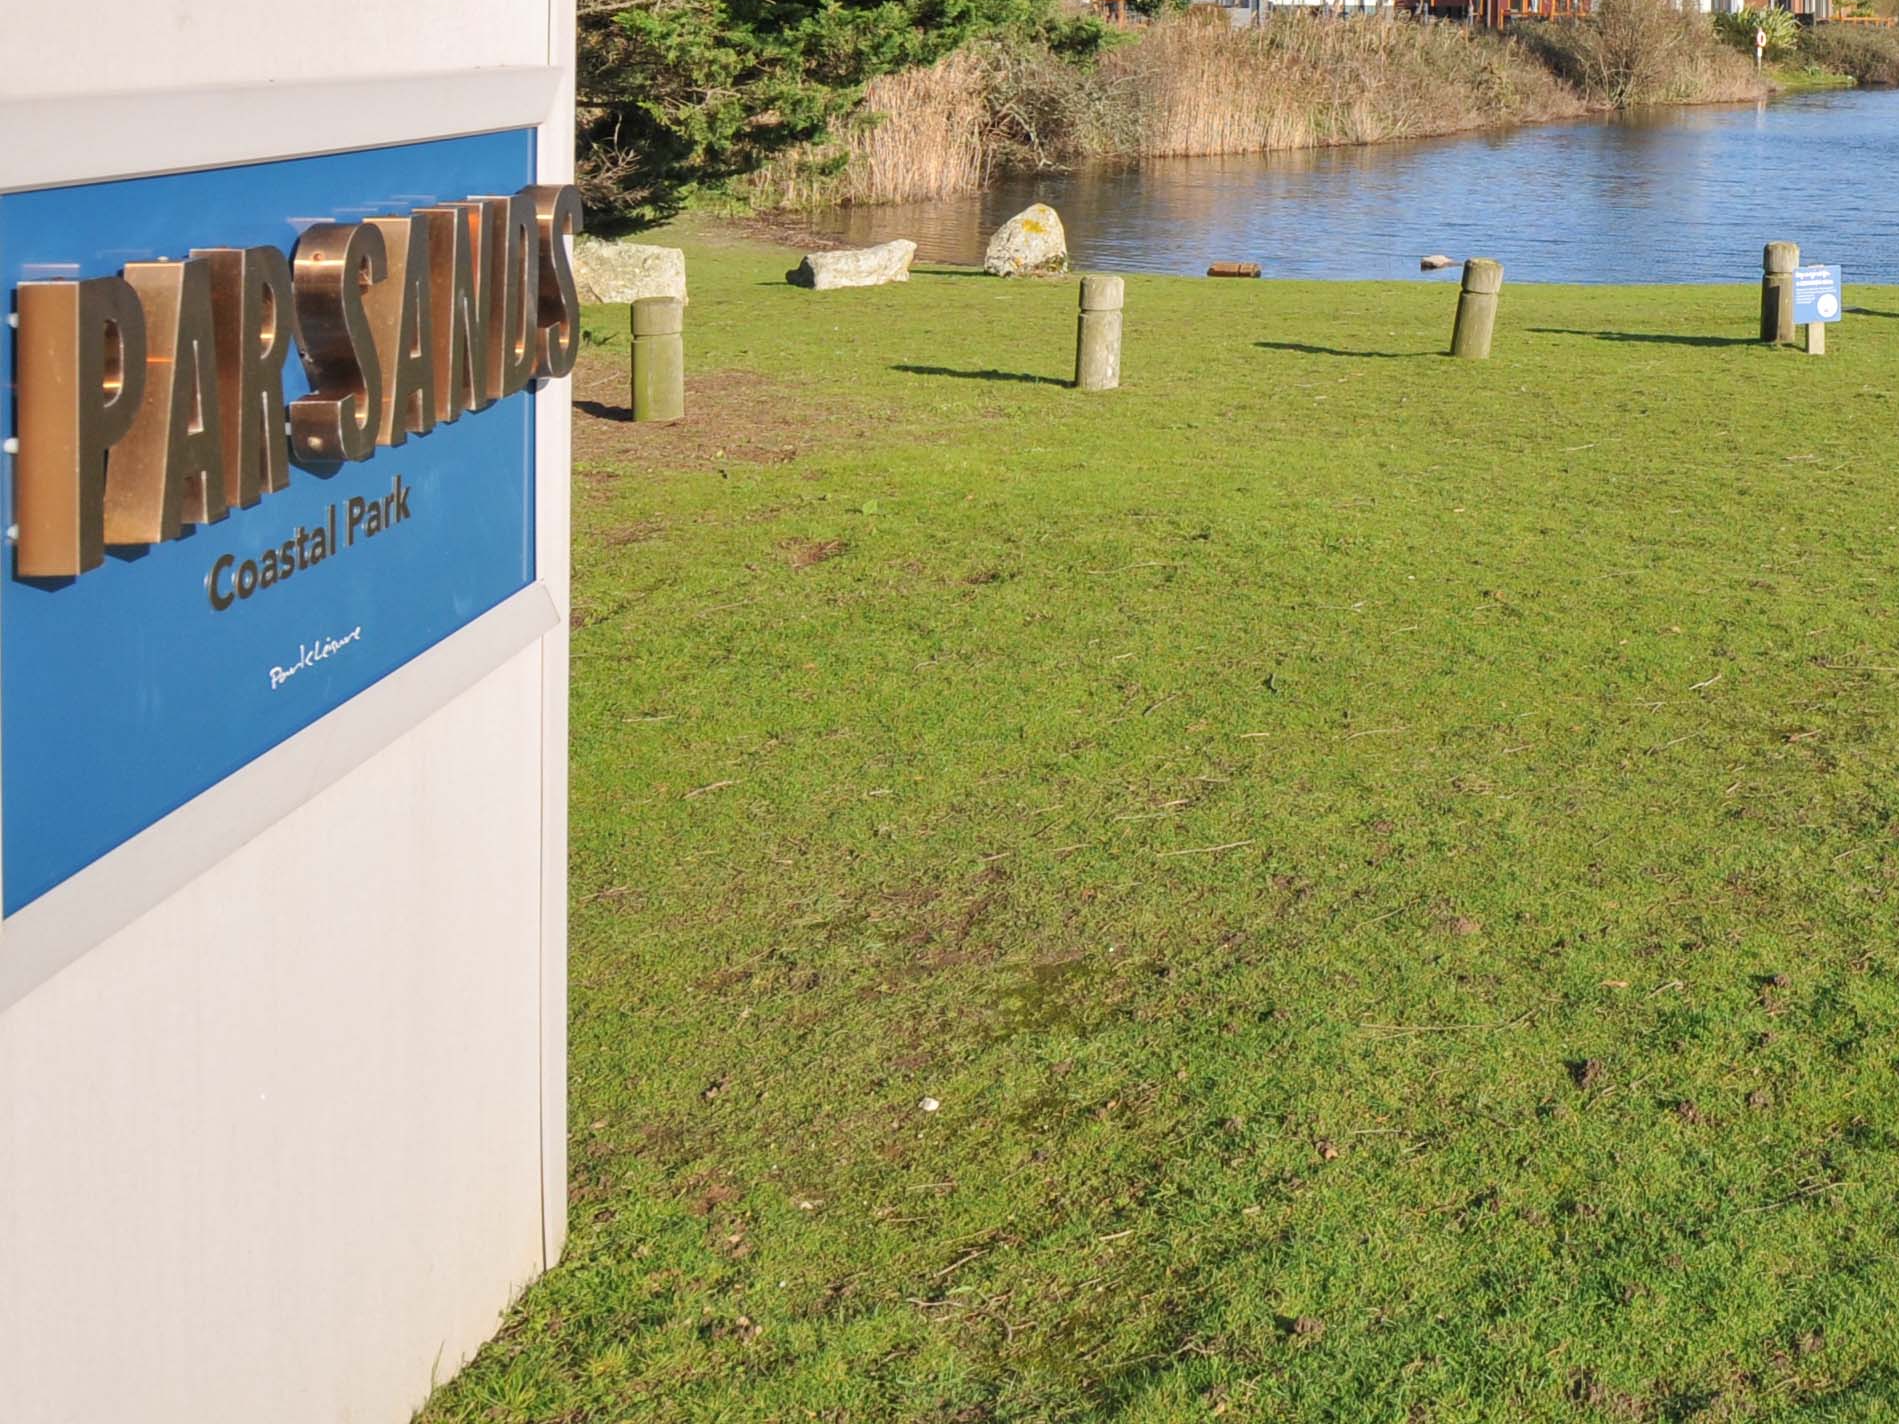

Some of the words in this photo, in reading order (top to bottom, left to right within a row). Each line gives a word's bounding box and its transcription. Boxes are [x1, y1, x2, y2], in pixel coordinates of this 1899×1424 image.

[16, 245, 291, 576] PAR
[289, 184, 583, 462] SANDS
[208, 504, 336, 611] Coastal
[346, 475, 411, 547] Park
